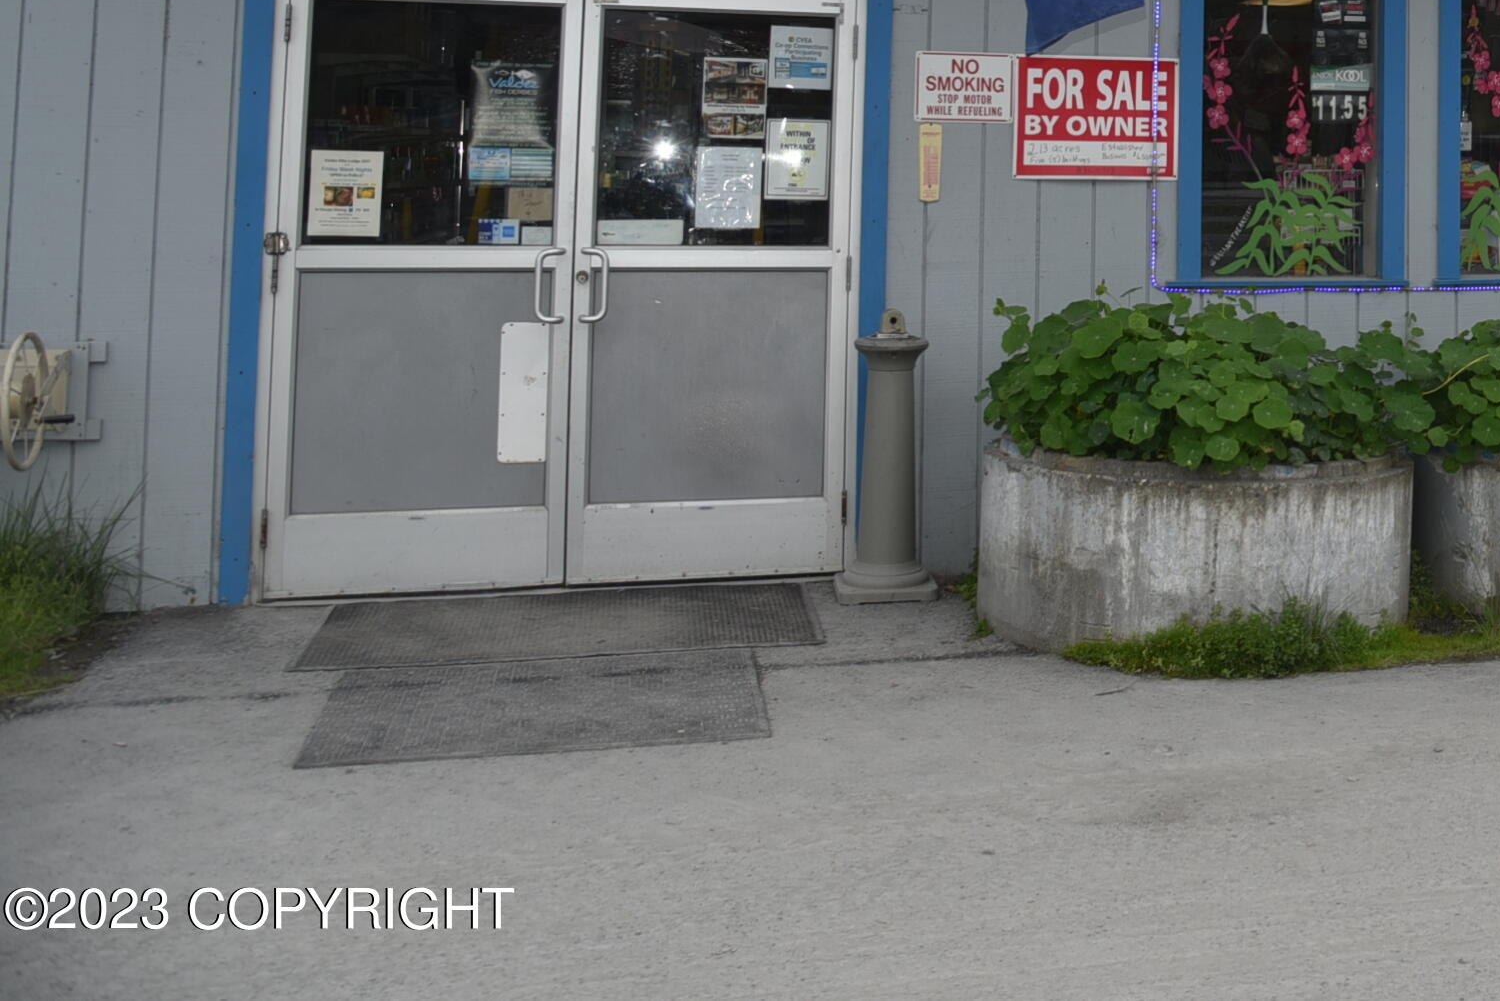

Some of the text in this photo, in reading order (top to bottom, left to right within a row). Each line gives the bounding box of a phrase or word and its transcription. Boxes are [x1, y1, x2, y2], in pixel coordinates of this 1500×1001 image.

[951, 59, 979, 74] NO
[1335, 69, 1367, 82] KOOL
[926, 75, 1005, 93] SMOKING
[1026, 68, 1168, 112] FOR SALE
[937, 94, 992, 105] STOP MOTOR
[926, 105, 1003, 117] WHILE REFUELING
[1312, 95, 1367, 120] $11.55
[1024, 115, 1168, 137] BY OWNER
[780, 143, 816, 151] ENTRANCE
